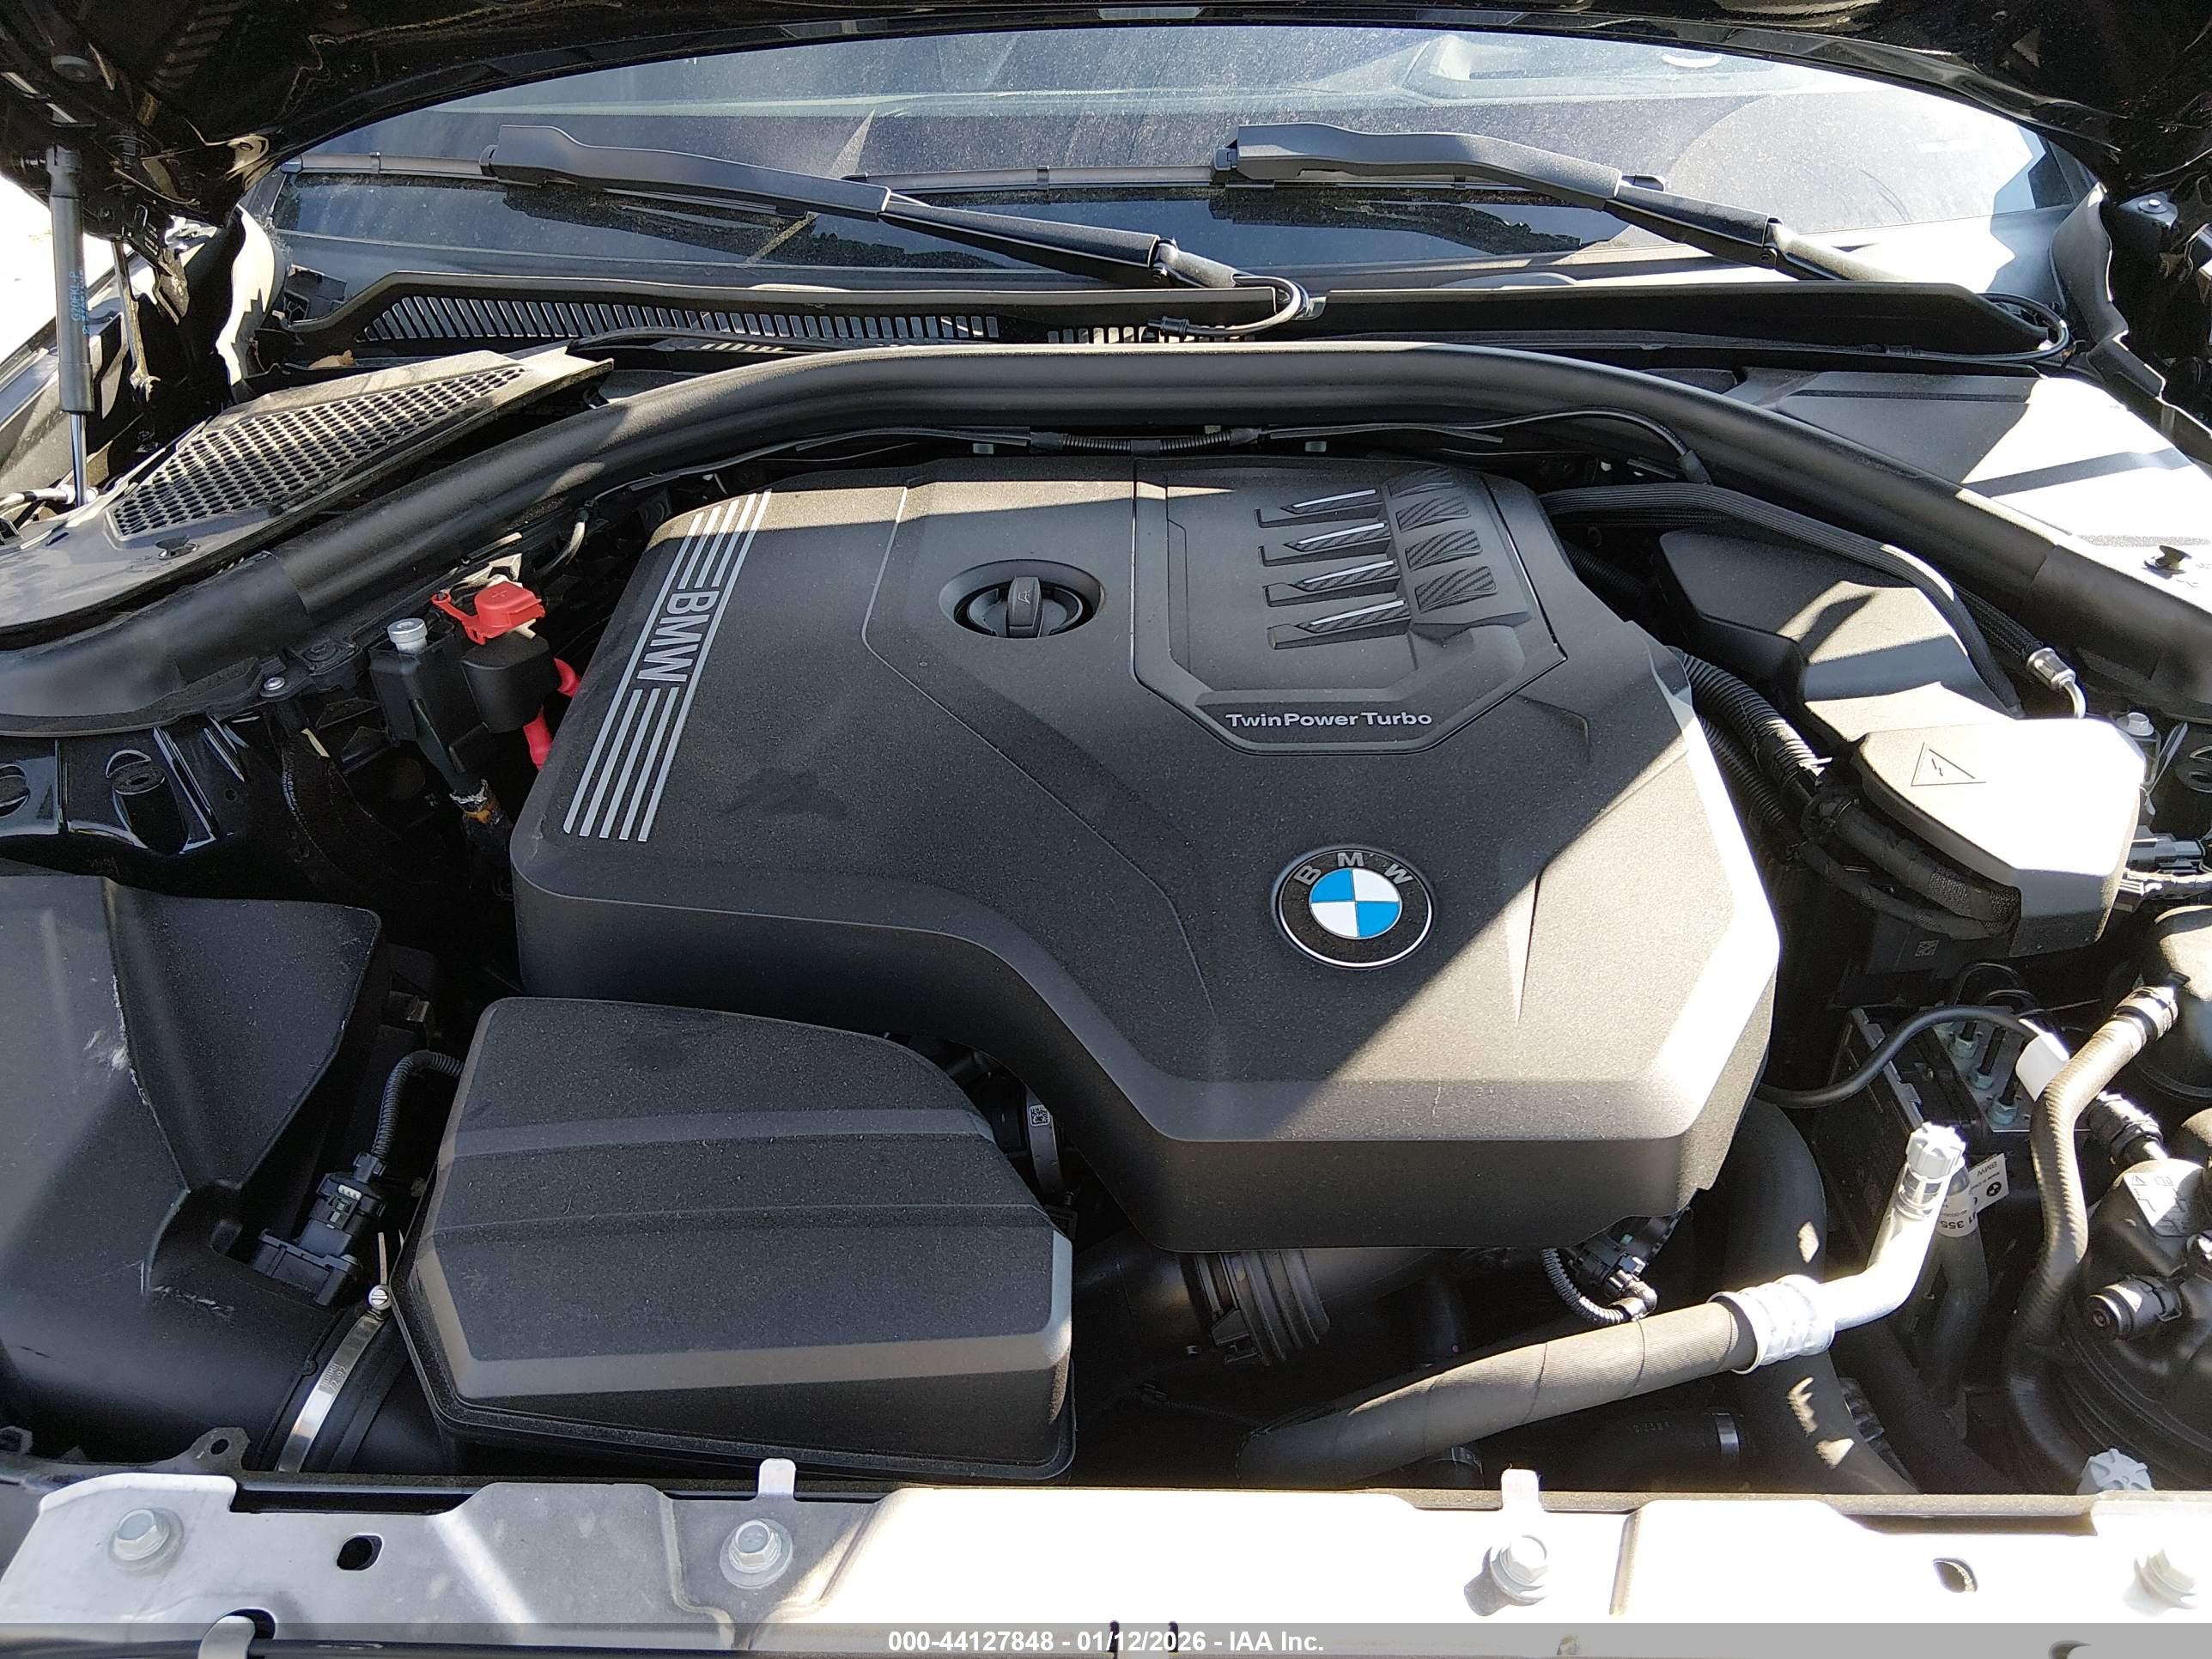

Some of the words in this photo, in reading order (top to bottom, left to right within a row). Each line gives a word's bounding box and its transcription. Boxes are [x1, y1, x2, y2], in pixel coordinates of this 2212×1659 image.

[636, 590, 720, 683] BMW
[1225, 713, 1358, 727] TwinPower
[1360, 711, 1432, 726] Turbo
[1293, 852, 1413, 885] BMW
[1977, 1161, 1997, 1176] BMW
